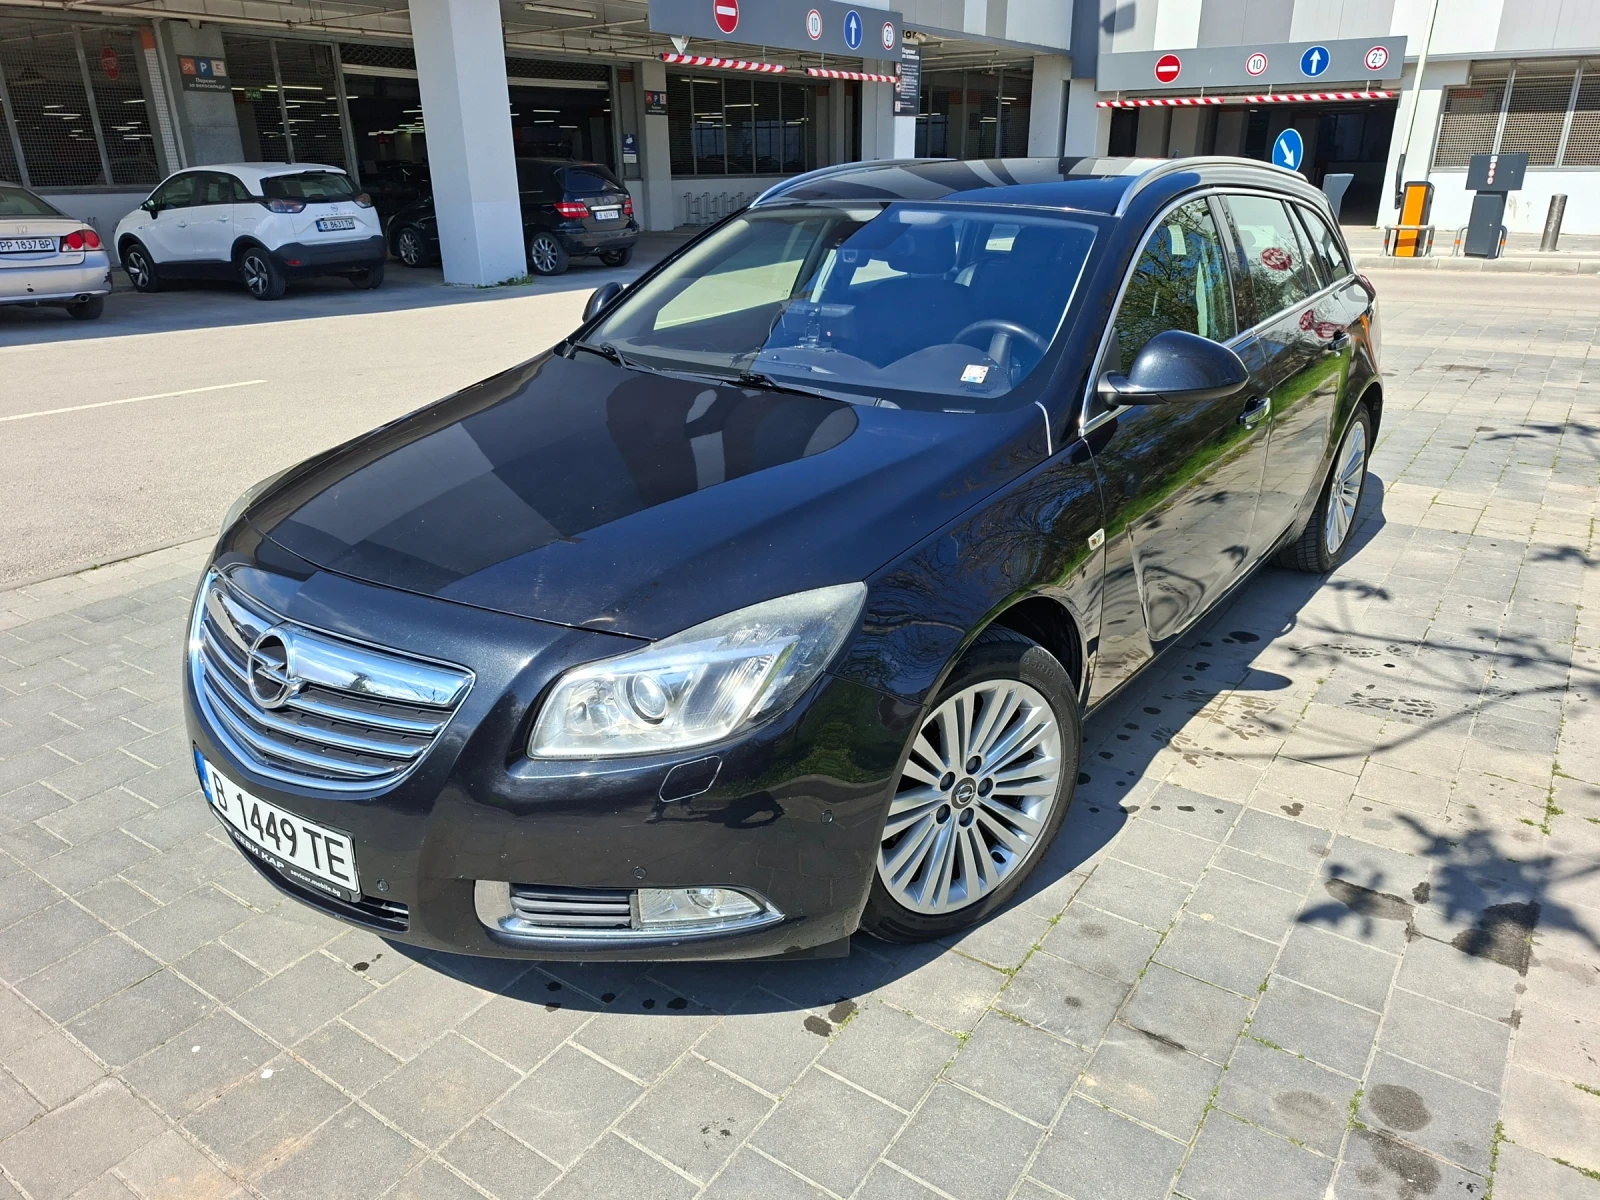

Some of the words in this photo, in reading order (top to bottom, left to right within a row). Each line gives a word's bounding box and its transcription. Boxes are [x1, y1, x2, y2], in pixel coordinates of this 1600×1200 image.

[811, 17, 818, 32] 10
[199, 62, 207, 72] P
[1252, 59, 1262, 70] 10
[322, 221, 329, 229] B
[0, 241, 13, 250] PP
[15, 240, 37, 250] 1837
[38, 239, 52, 249] BP
[211, 770, 228, 812] B
[236, 793, 298, 858] 1449
[302, 826, 350, 882] TE
[233, 832, 259, 855] СЕВИ
[261, 852, 285, 869] КАР
[290, 869, 341, 897] sevicar.mobile.bg
